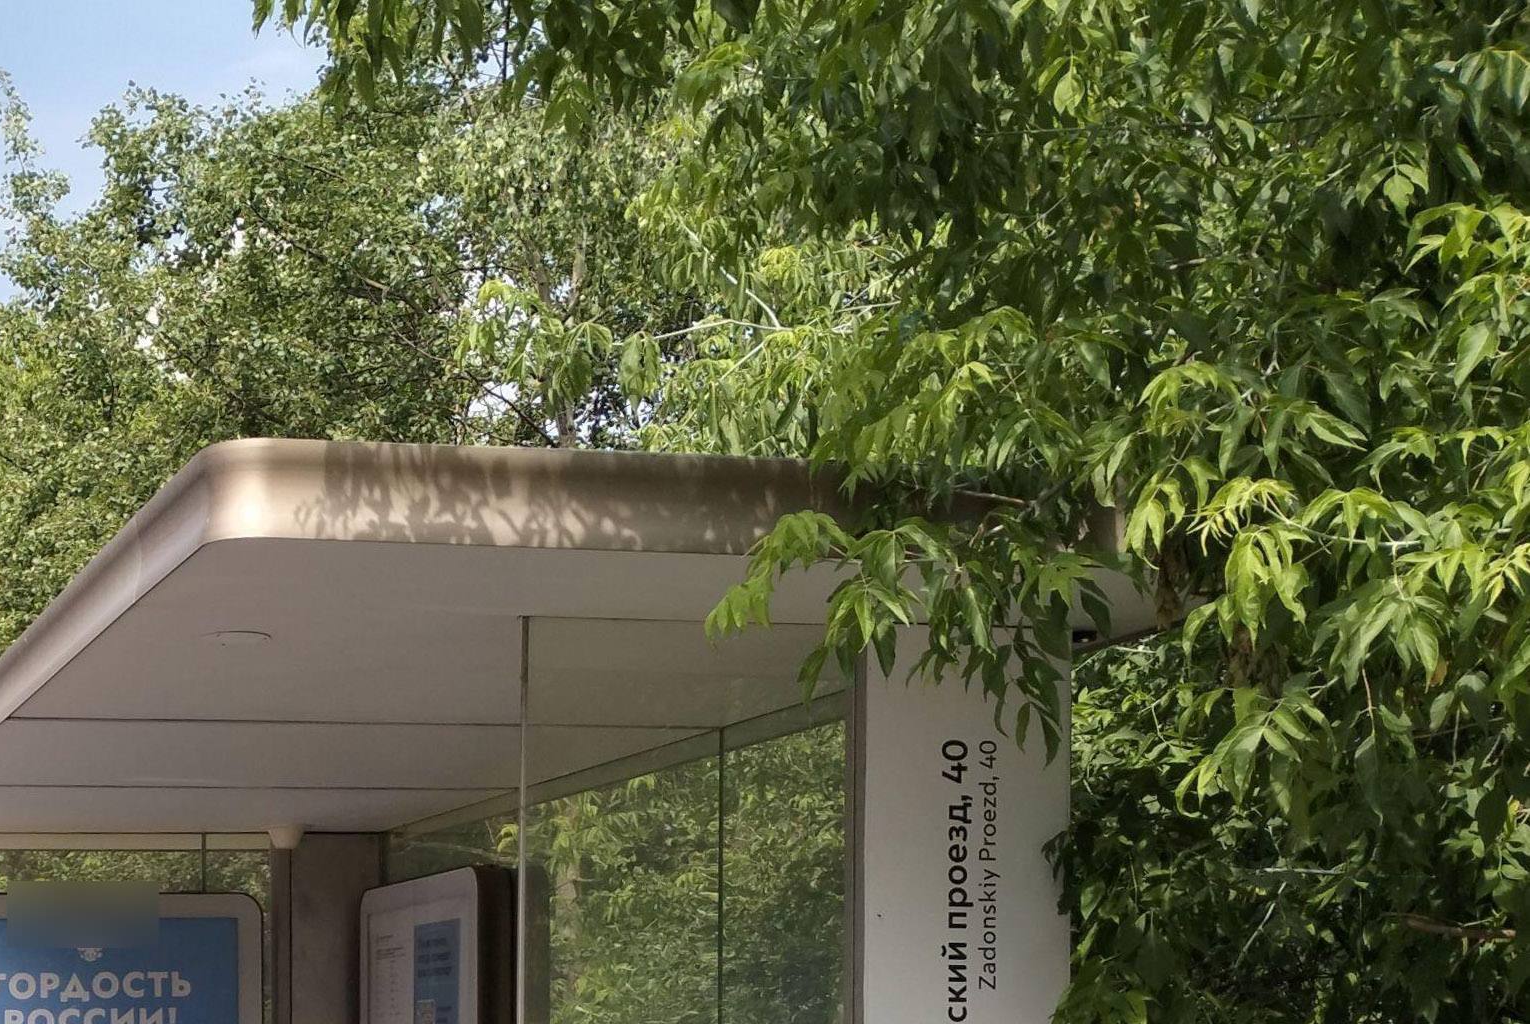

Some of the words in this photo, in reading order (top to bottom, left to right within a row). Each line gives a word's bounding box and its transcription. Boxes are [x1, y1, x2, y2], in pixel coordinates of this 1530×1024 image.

[942, 740, 968, 784] 40
[978, 740, 997, 769] 40
[978, 776, 1000, 861] Proezd,
[948, 795, 974, 928] проезд,
[978, 869, 1001, 990] Zadonskiy
